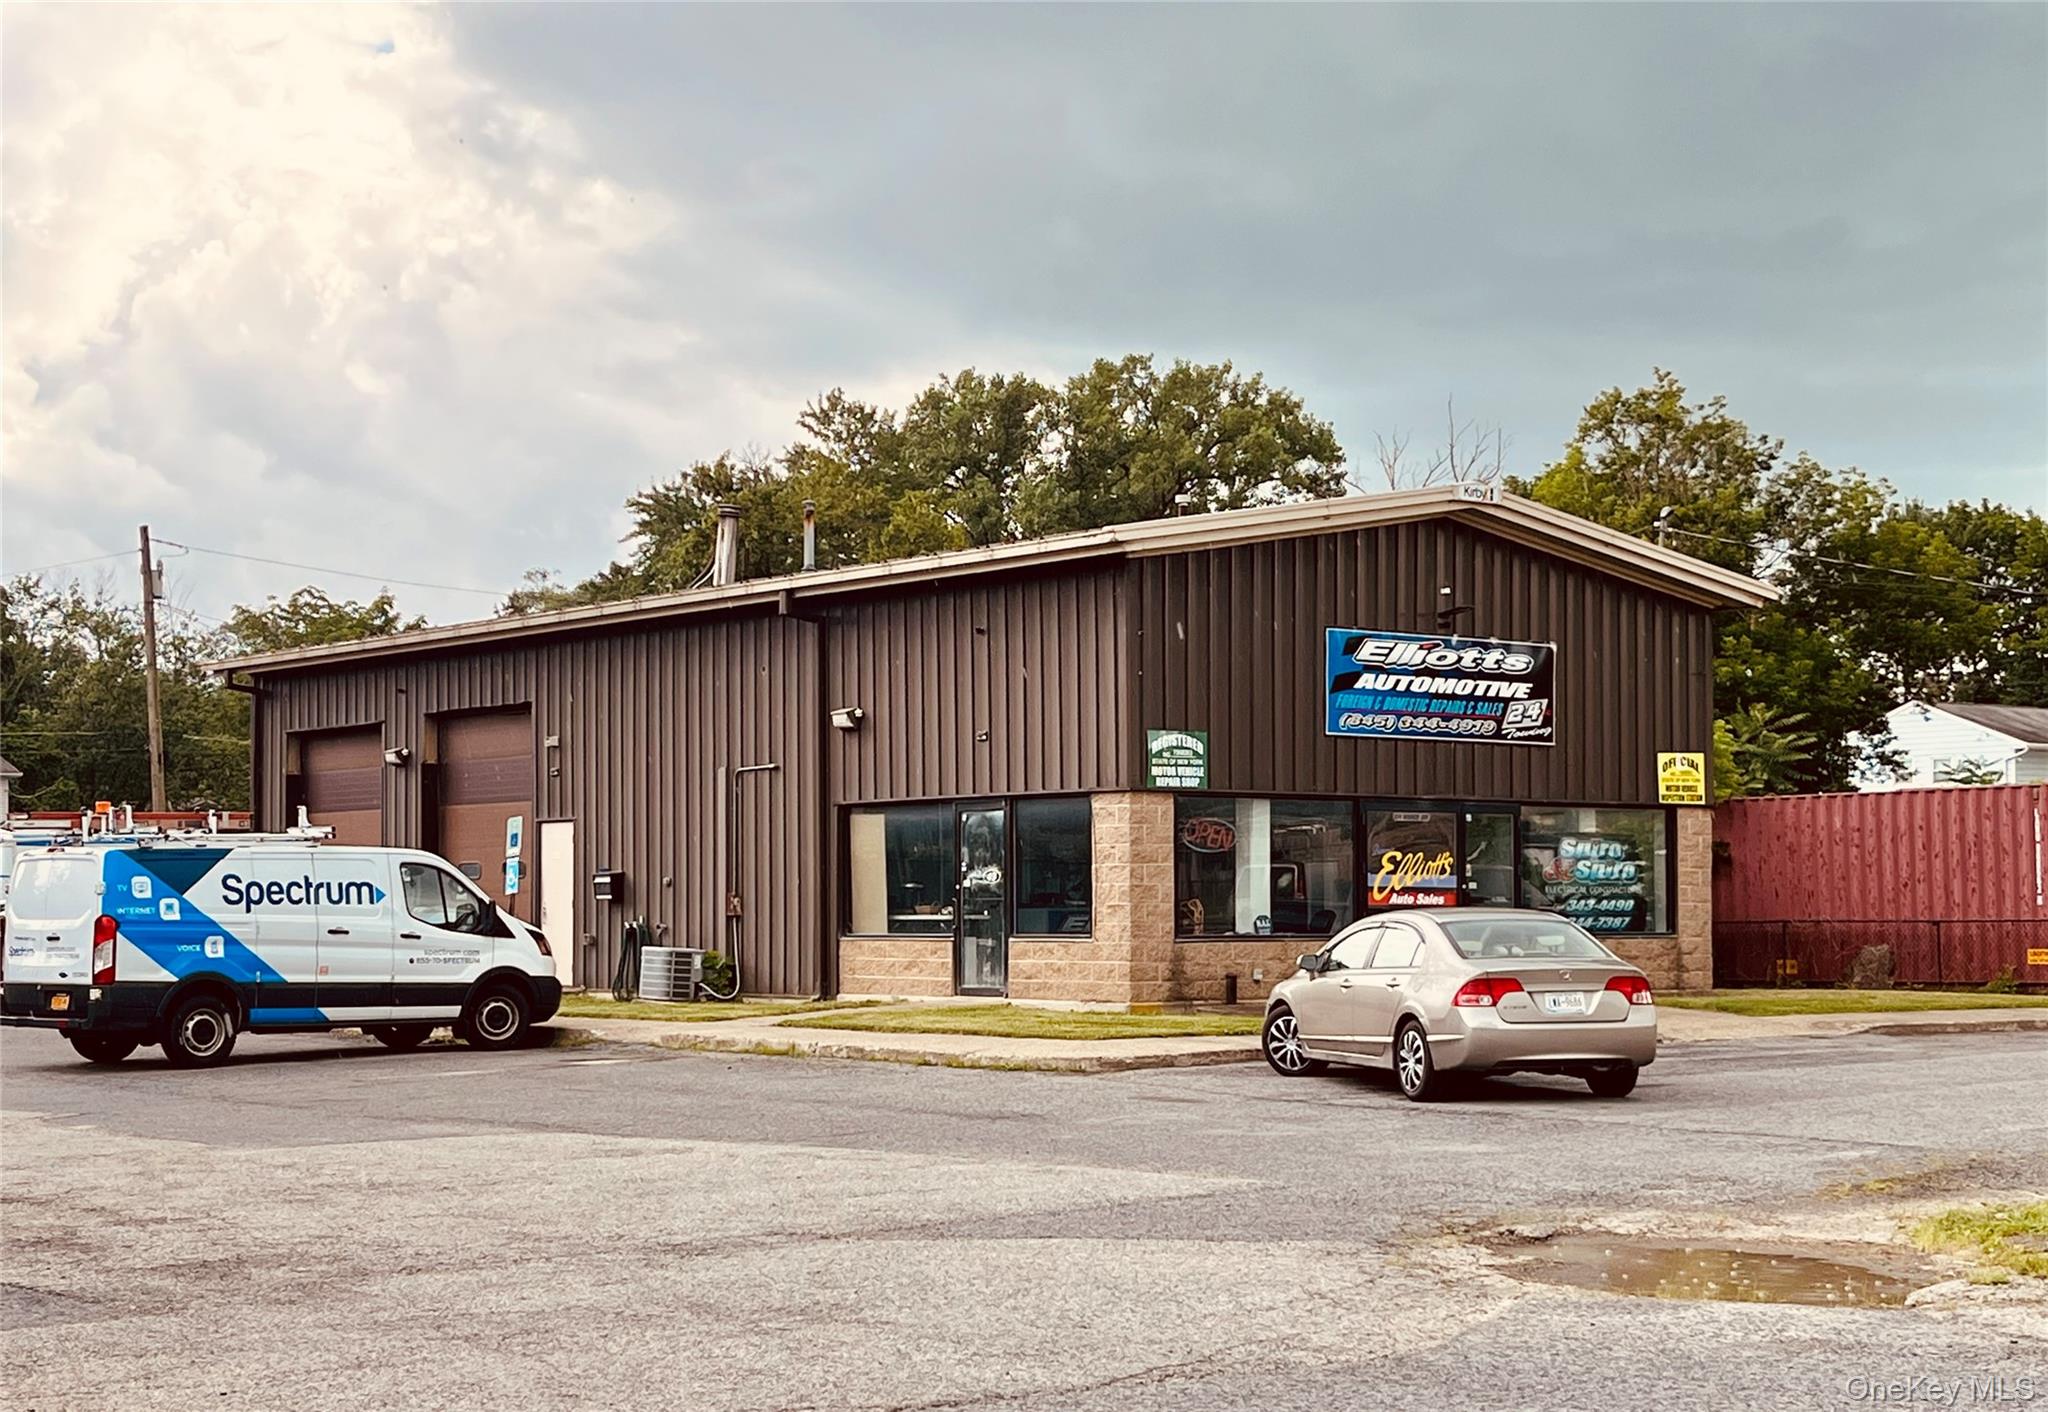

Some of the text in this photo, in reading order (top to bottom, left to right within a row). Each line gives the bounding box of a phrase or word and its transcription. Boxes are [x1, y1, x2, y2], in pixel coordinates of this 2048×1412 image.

[1354, 639, 1534, 674] Elliotts
[1353, 673, 1533, 699] AUTOMOTIVE
[1336, 694, 1372, 709] FOREIGN
[1382, 697, 1429, 712] DOMESTIC
[1429, 699, 1466, 714] REPAIRS
[1475, 702, 1504, 716] SALES
[1507, 701, 1543, 724] 24
[1340, 713, 1397, 731] (845)
[1501, 727, 1552, 739] Towing
[1151, 733, 1204, 755] REGISTERED
[1151, 766, 1204, 777] MOTOR VEHICLE
[1156, 777, 1181, 787] REPAIR
[1184, 820, 1233, 849] OPEN
[1373, 850, 1453, 900] Elliott's
[117, 884, 128, 892] TV
[221, 873, 375, 914] Spectrum
[1389, 893, 1445, 905] Auto Sales
[116, 906, 155, 915] INTERNET
[176, 944, 201, 952] VOICE
